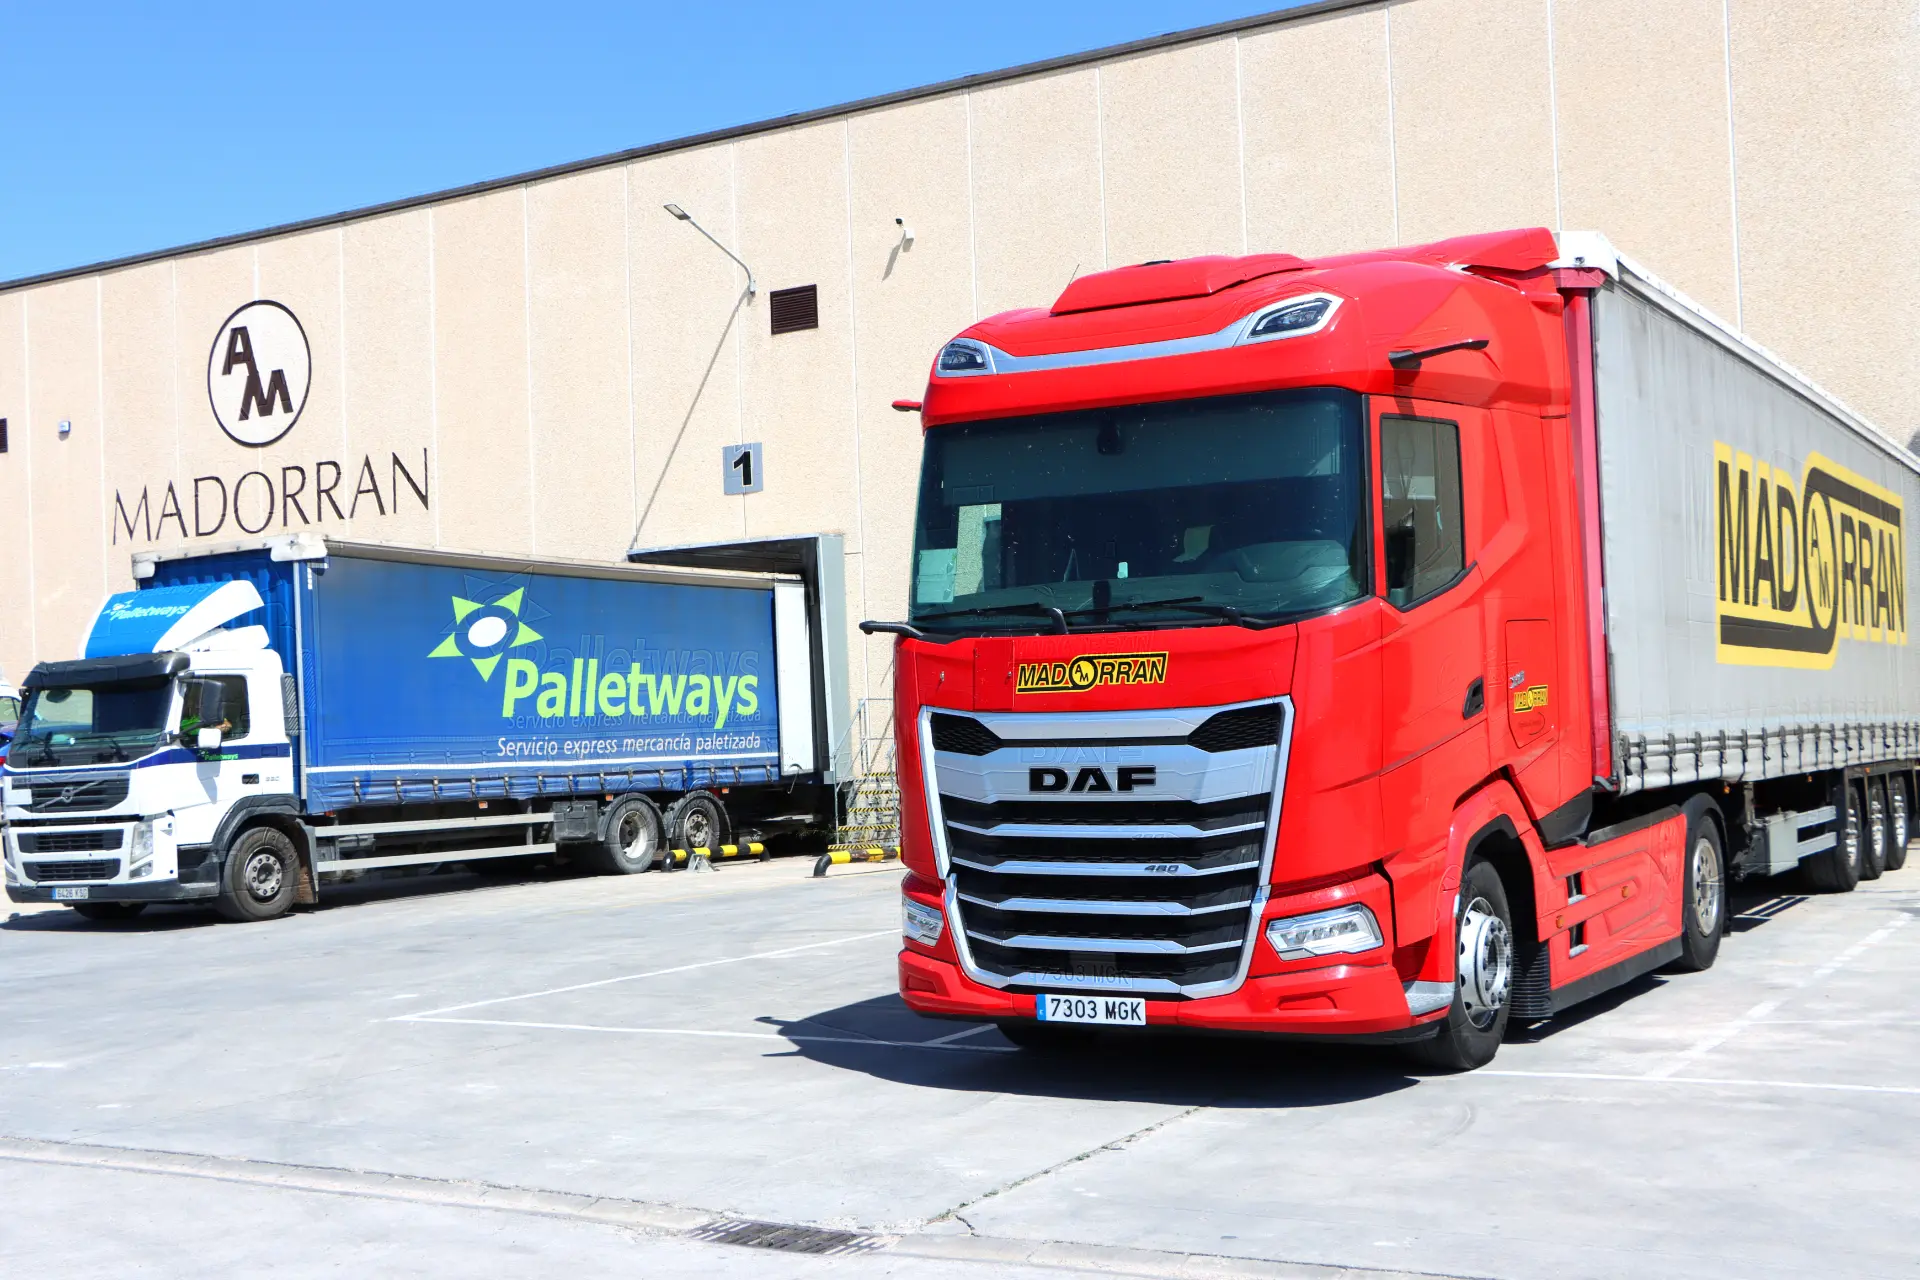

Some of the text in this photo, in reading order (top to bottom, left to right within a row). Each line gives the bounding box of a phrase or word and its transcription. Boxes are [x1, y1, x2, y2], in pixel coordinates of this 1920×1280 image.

[733, 450, 752, 486] 1
[113, 447, 430, 546] MADORRAN
[1718, 459, 1905, 654] MADORRAN
[109, 605, 190, 621] Palletways
[1017, 653, 1168, 692] MADORRAN
[502, 657, 759, 730] Palletways
[497, 732, 761, 759] Servicio express mercancía paletizada
[1029, 766, 1156, 792] DAF
[1051, 998, 1142, 1021] 7303 MGK
